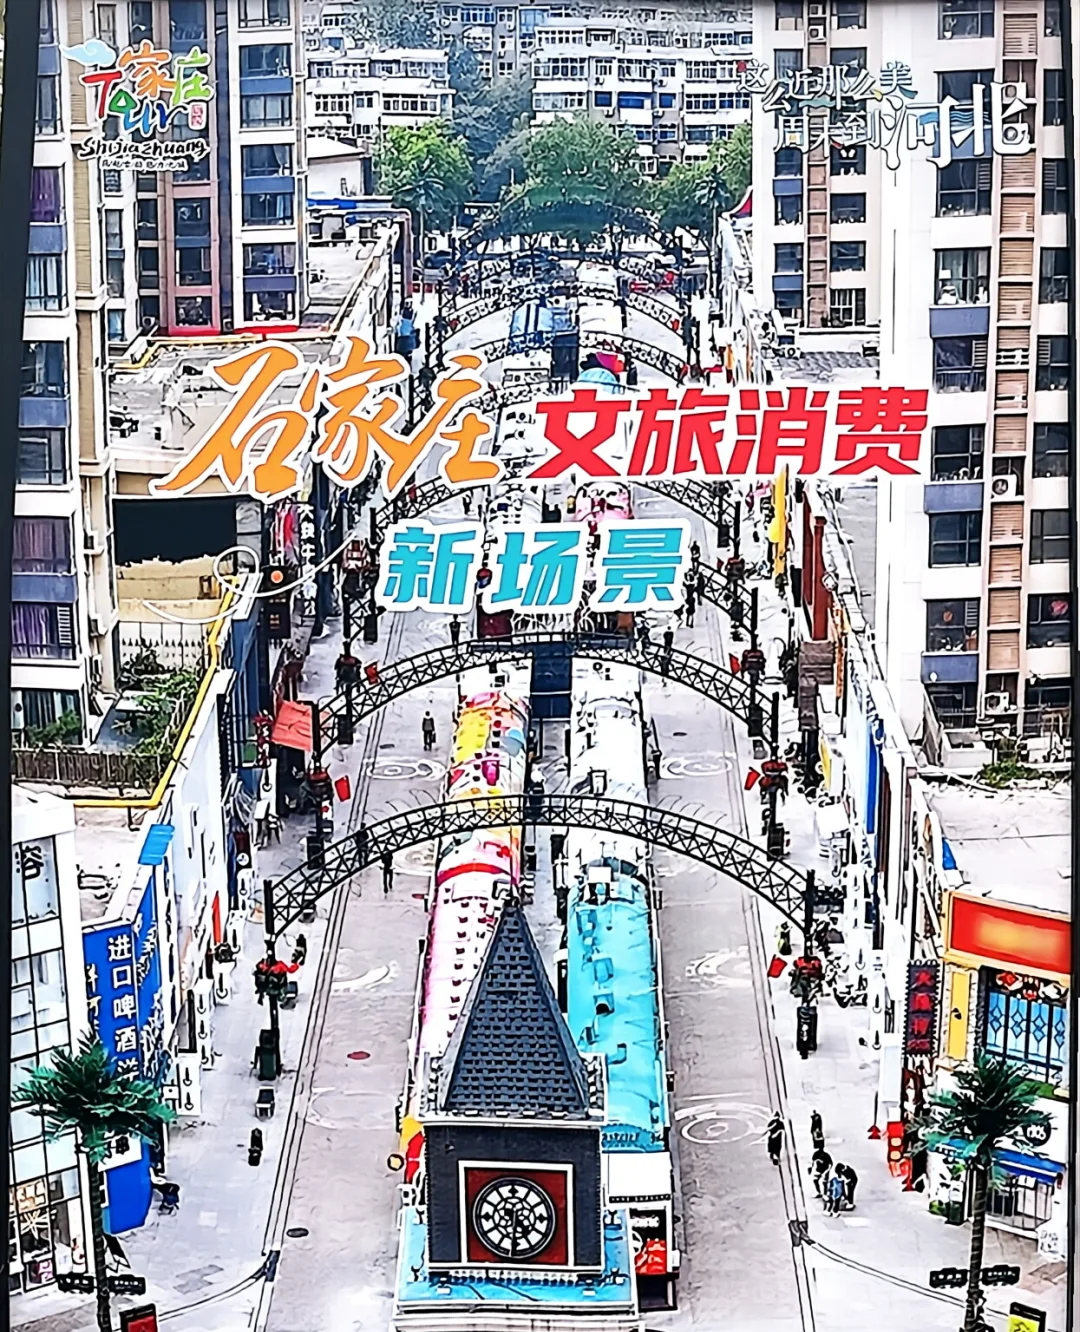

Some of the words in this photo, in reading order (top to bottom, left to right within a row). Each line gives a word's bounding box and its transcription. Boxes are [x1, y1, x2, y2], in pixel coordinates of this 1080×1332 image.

[153, 336, 504, 495] 石家庄
[525, 386, 930, 479] 文旅消费
[383, 526, 683, 607] 新场景
